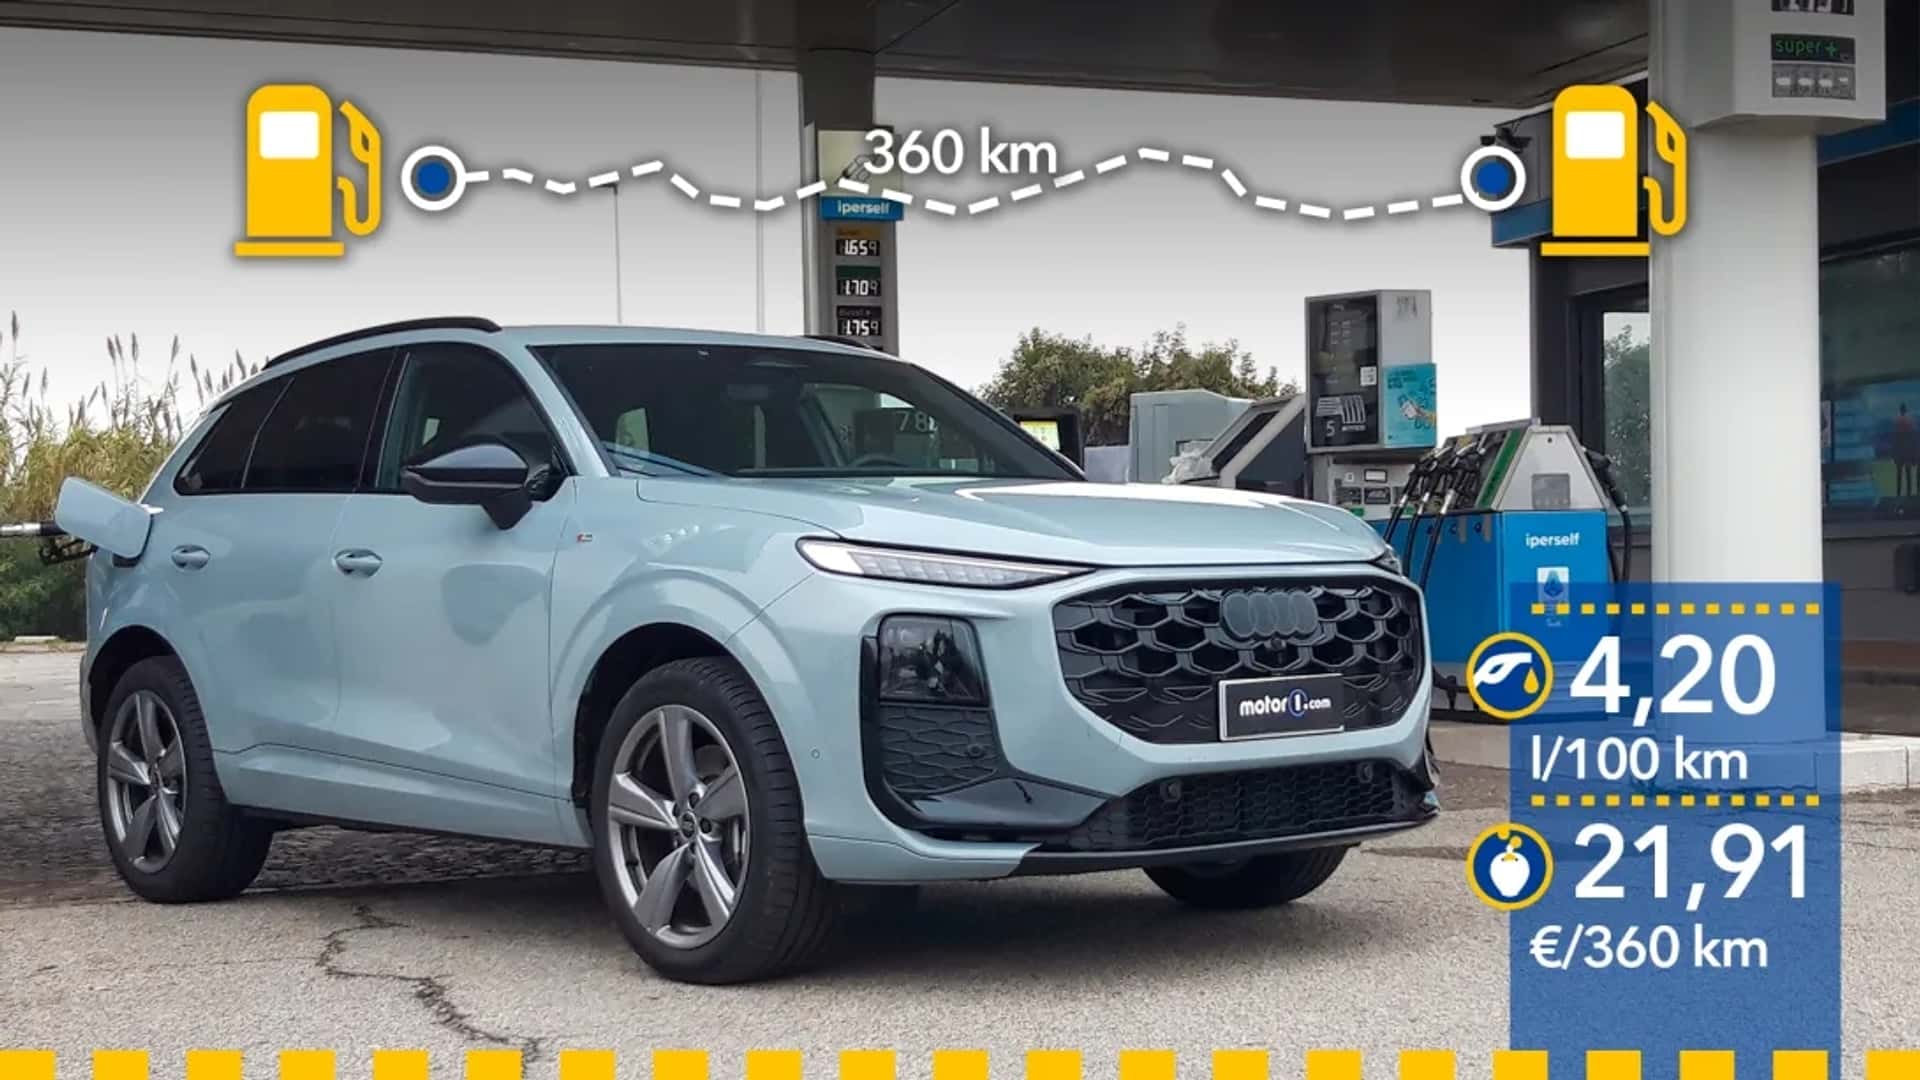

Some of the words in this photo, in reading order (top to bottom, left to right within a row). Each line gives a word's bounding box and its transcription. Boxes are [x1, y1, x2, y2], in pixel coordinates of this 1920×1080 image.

[837, 200, 890, 214] iperself
[1326, 420, 1336, 437] 5
[1525, 532, 1580, 549] iperself
